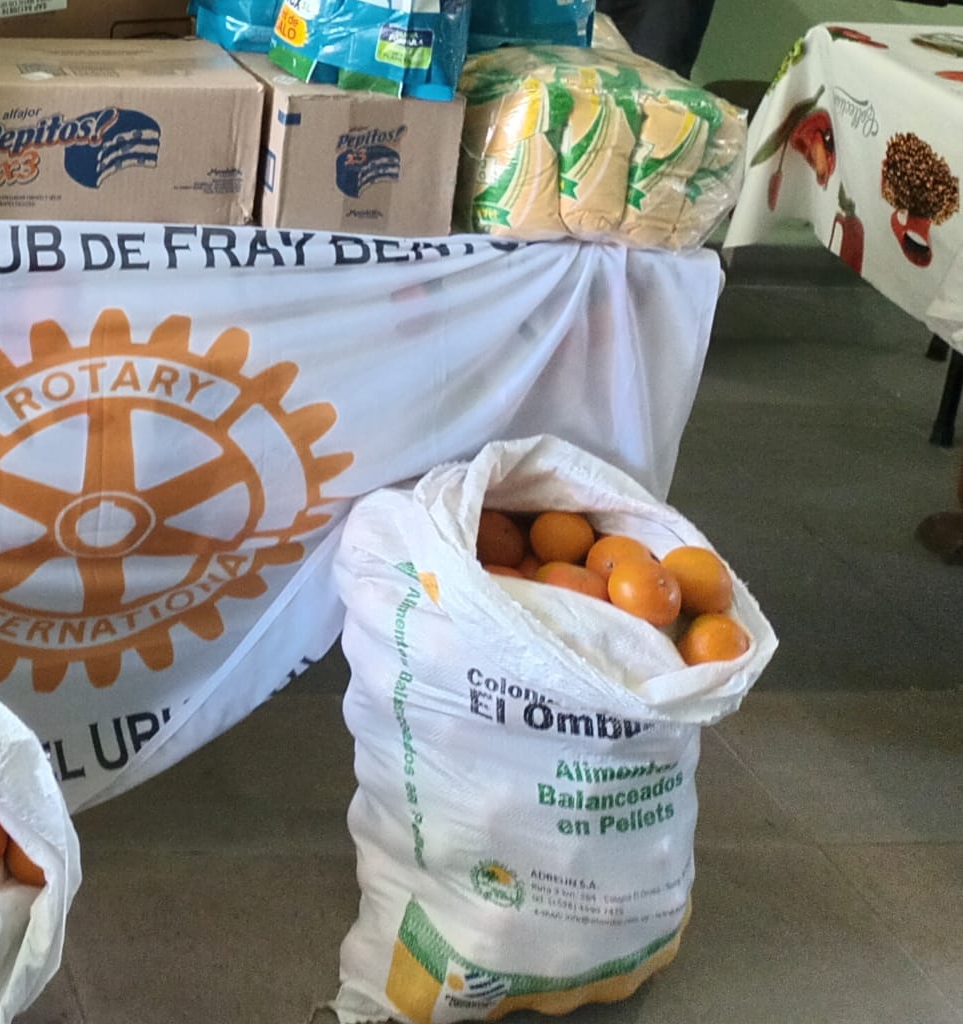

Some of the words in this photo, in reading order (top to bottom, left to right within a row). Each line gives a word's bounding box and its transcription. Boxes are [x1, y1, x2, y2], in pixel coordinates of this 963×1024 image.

[1, 106, 42, 121] alfajor
[336, 123, 408, 150] Pepitos!
[80, 232, 150, 271] DE
[163, 225, 315, 270] FRAY
[3, 359, 216, 421] ROTARY
[469, 687, 506, 725] El
[537, 771, 683, 812] Balanceados
[556, 817, 591, 836] en
[599, 801, 675, 836] Pellets
